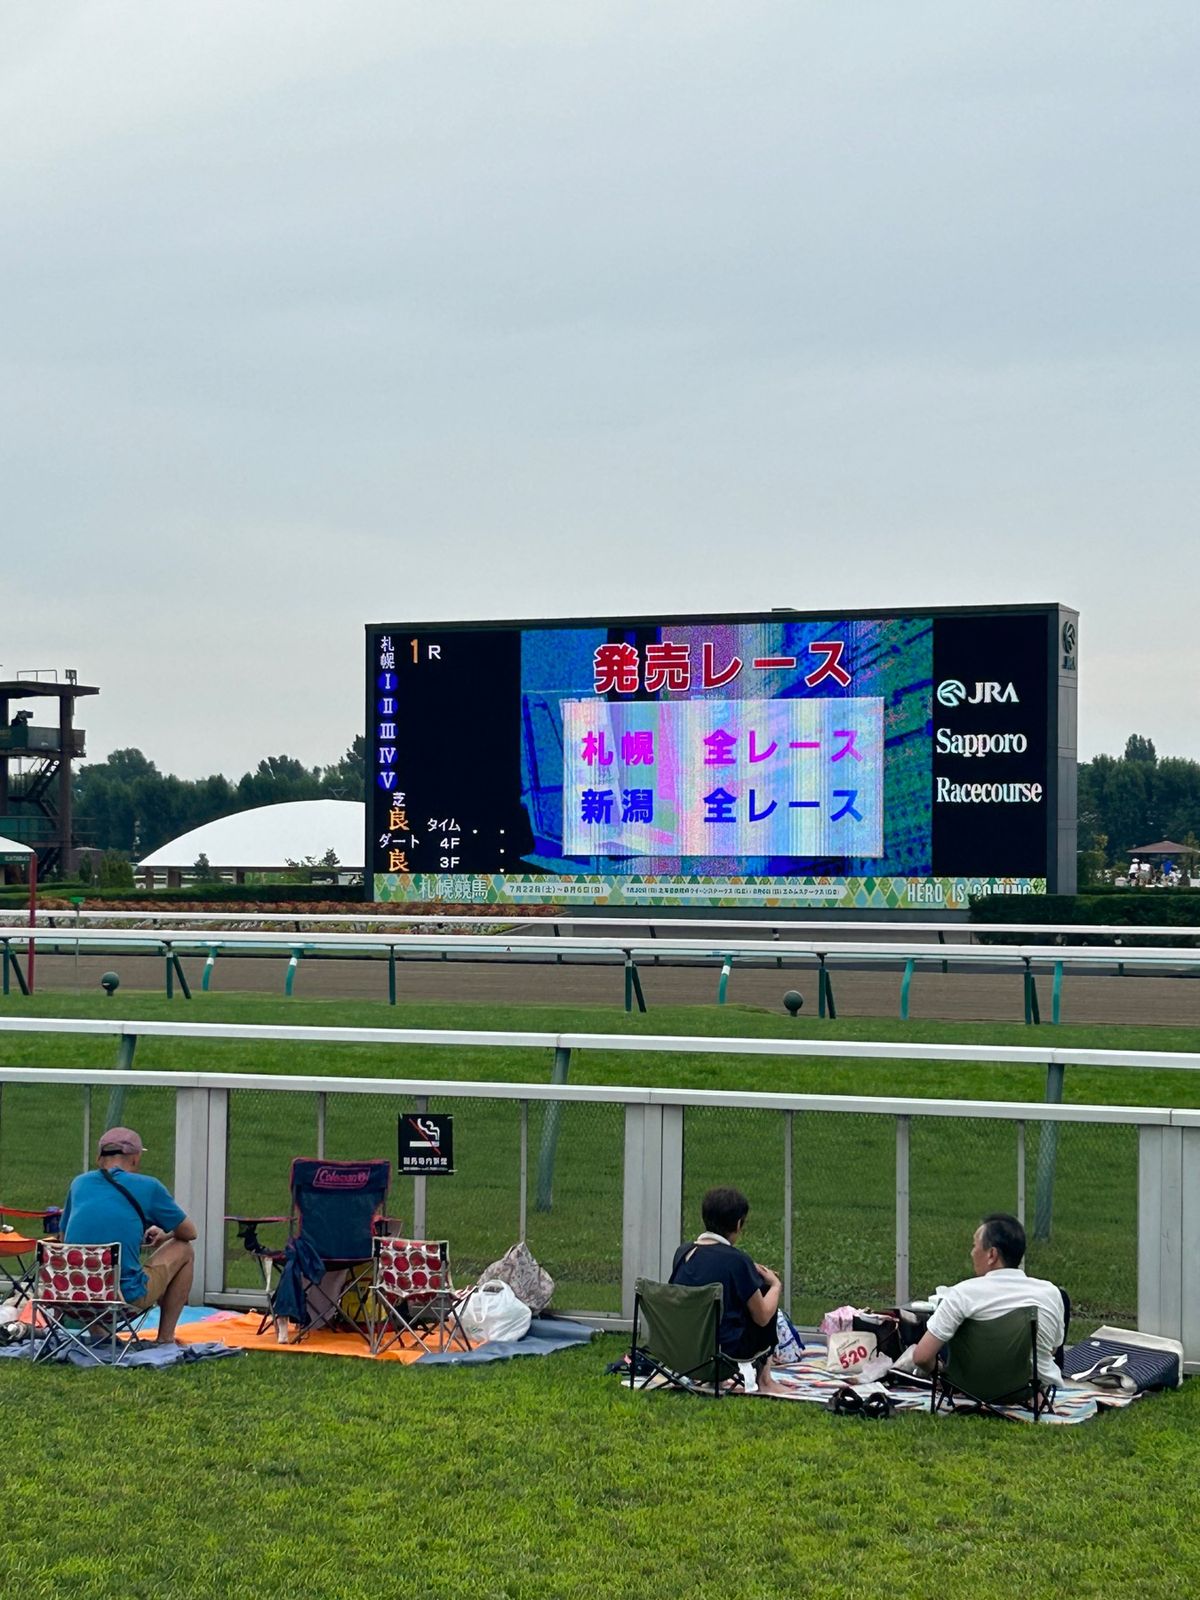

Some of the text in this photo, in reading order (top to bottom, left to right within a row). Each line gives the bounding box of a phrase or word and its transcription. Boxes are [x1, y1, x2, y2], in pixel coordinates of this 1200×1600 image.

[380, 636, 395, 669] 札幌
[410, 639, 441, 664] 1 R
[593, 641, 852, 693] 発売レース
[968, 682, 1020, 704] JRA
[581, 729, 863, 766] 札幌 全レース
[936, 728, 1028, 758] Sapporo
[392, 792, 406, 807] 芝
[936, 777, 1043, 803] Racecourse
[581, 787, 863, 825] 新潟 全レース
[388, 807, 410, 831] 良
[427, 818, 461, 832] タイム
[379, 834, 420, 849] ダート
[439, 838, 460, 849] 4F
[388, 849, 410, 872] 良
[439, 857, 460, 868] 3F
[419, 878, 489, 900] 札幌競馬
[907, 883, 943, 902] HERO
[952, 883, 964, 902] IS
